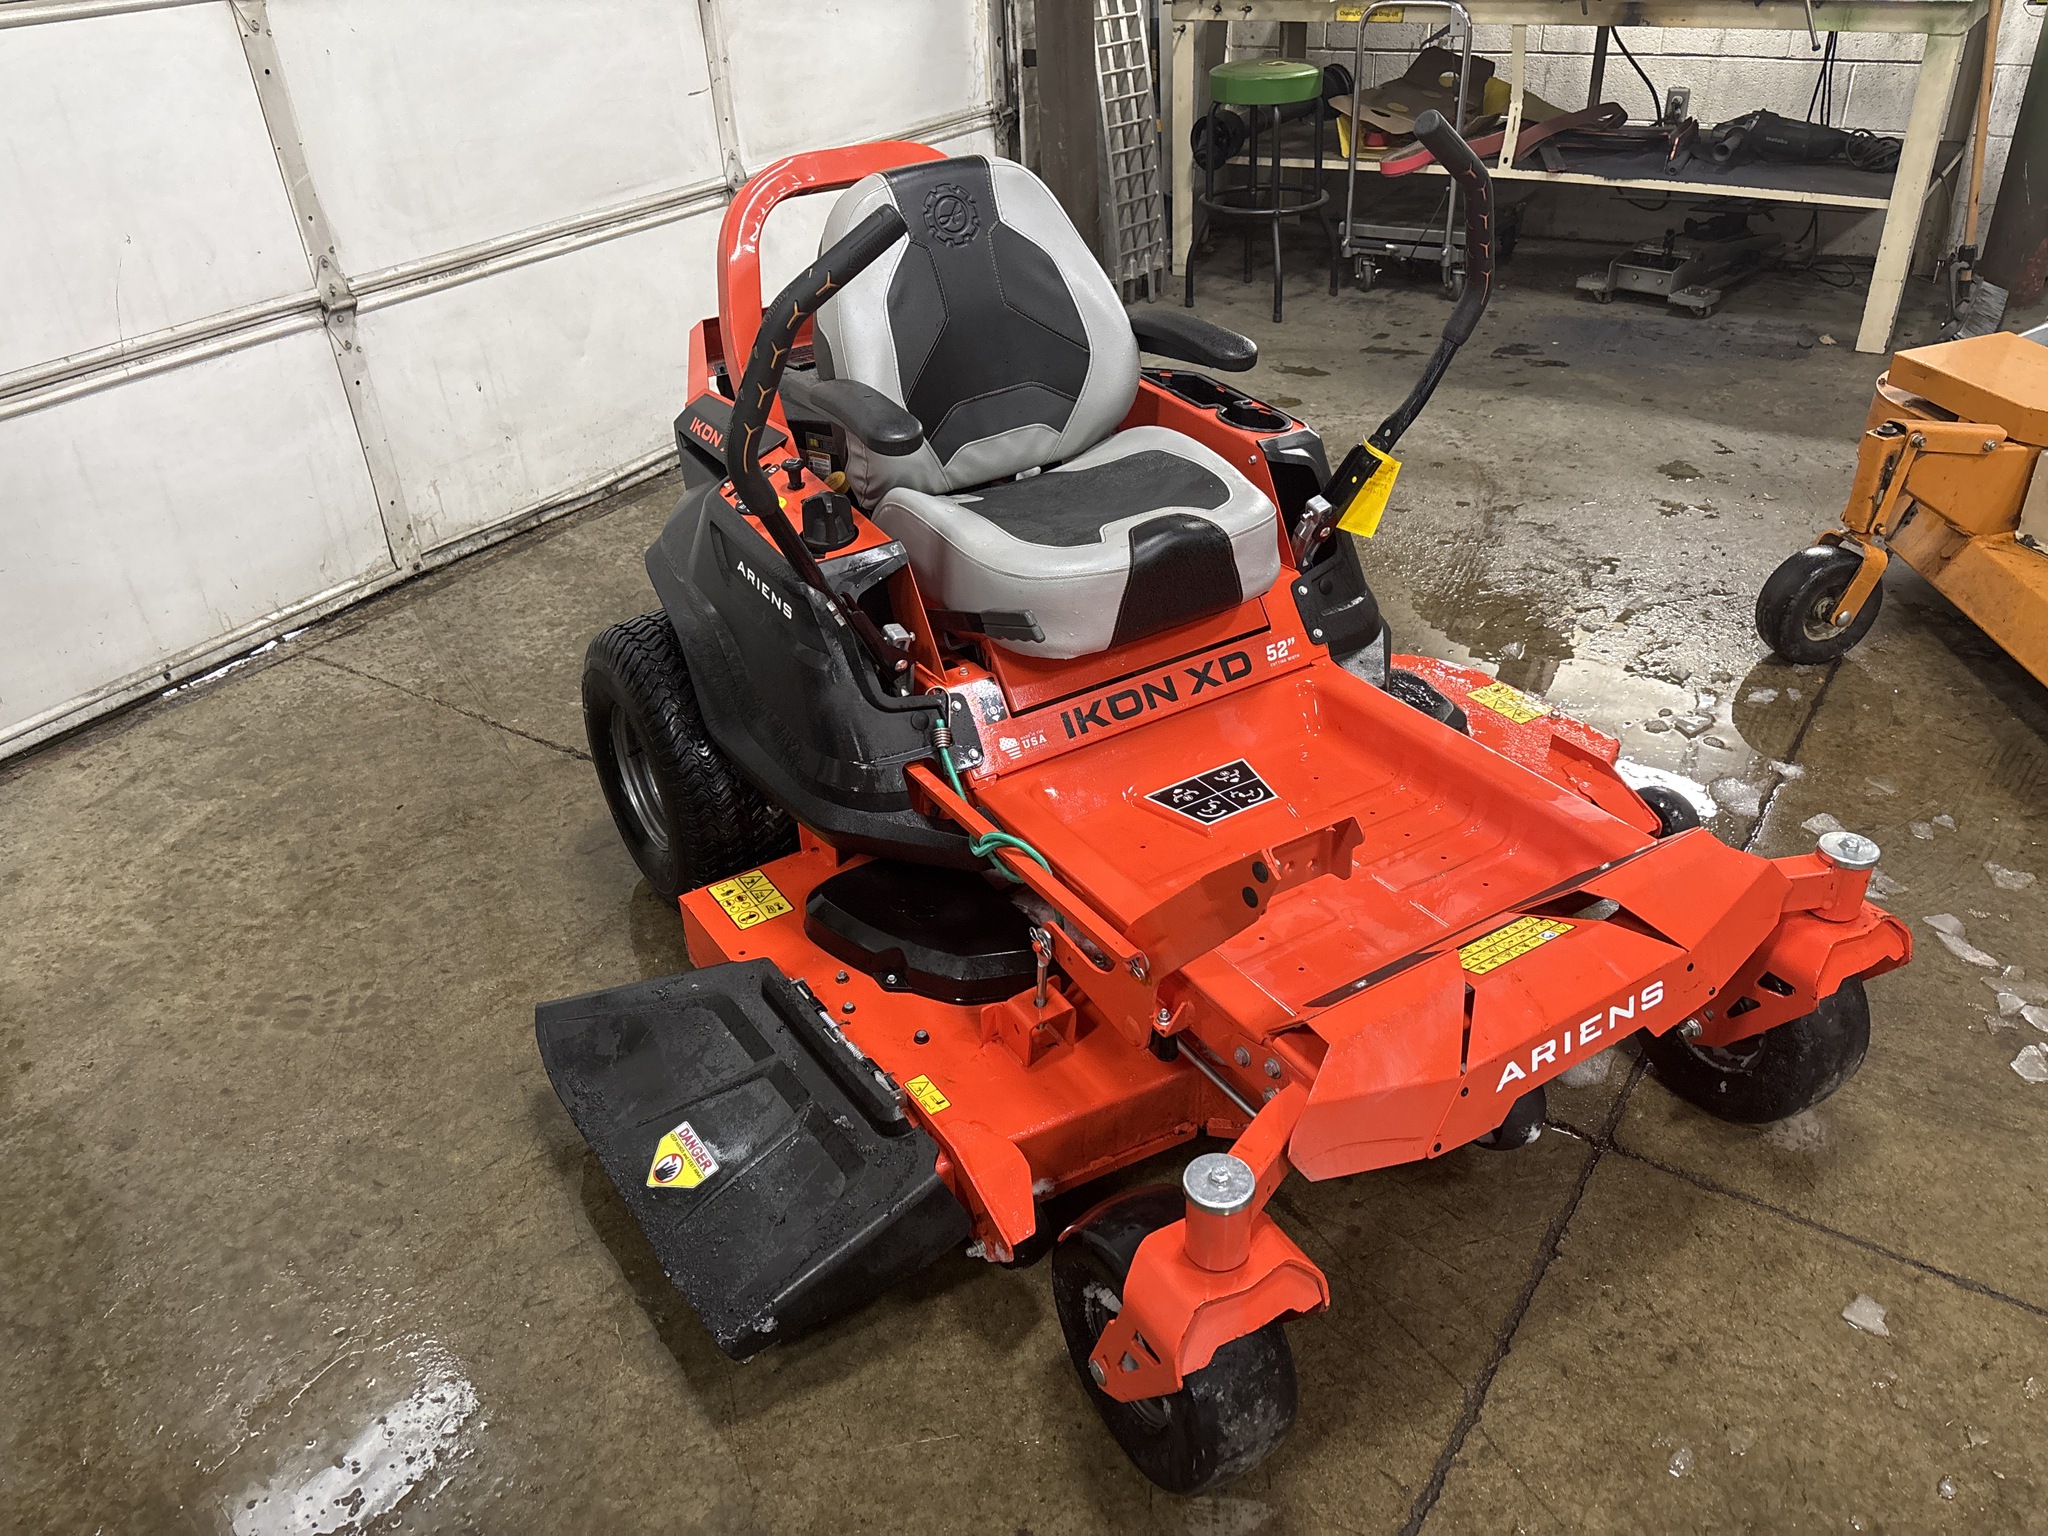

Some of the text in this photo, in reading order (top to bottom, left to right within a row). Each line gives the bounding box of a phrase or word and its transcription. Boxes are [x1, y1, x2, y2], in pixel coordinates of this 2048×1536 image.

[689, 416, 723, 448] IKON
[737, 560, 793, 620] ARIENS
[1060, 651, 1252, 739] IKON XD
[1021, 734, 1048, 749] USA
[1495, 980, 1664, 1093] ARIENS
[678, 1127, 712, 1172] DANGER
